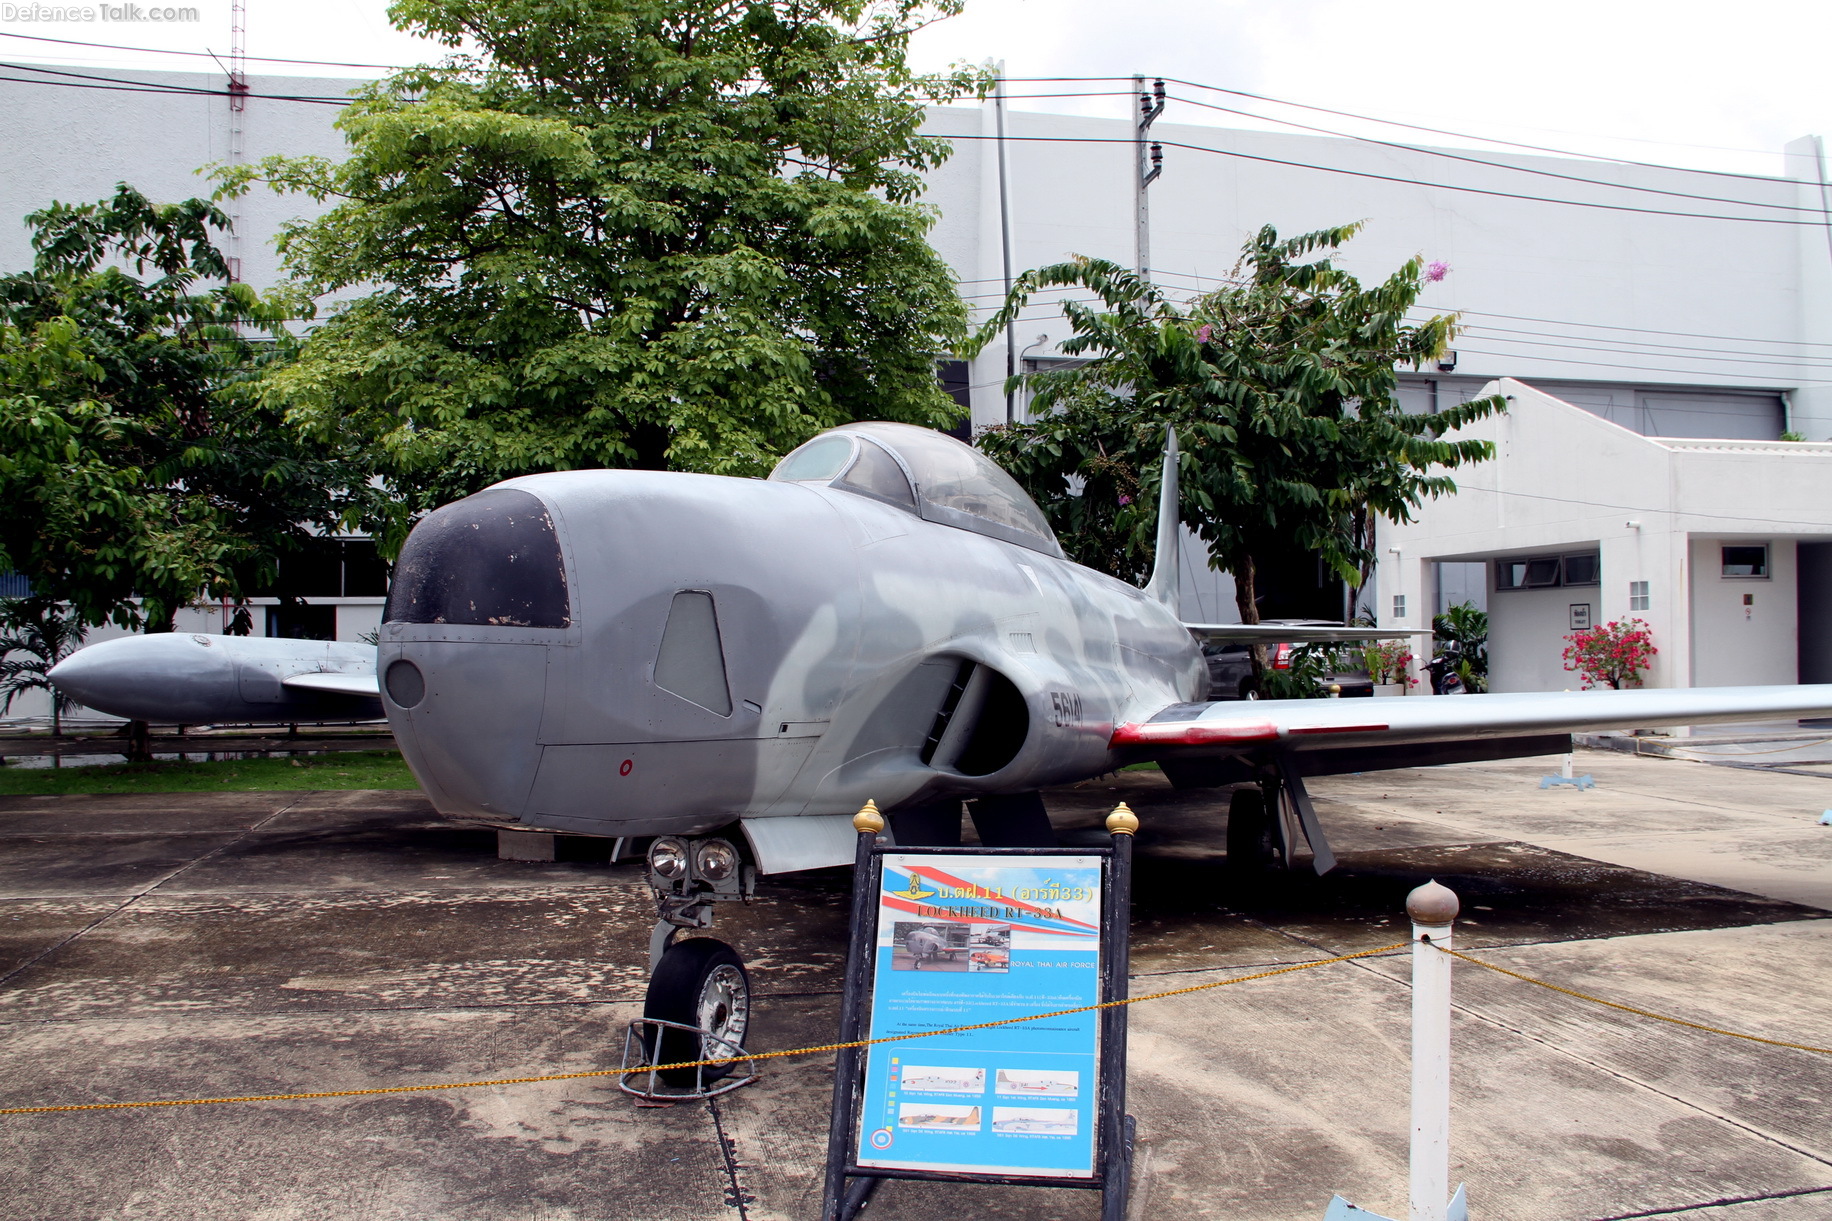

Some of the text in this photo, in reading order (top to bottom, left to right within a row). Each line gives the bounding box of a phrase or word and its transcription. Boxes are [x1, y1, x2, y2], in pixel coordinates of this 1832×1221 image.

[917, 905, 1064, 920] LOCKHEED RT-33A
[1010, 960, 1034, 968] ROYAL
